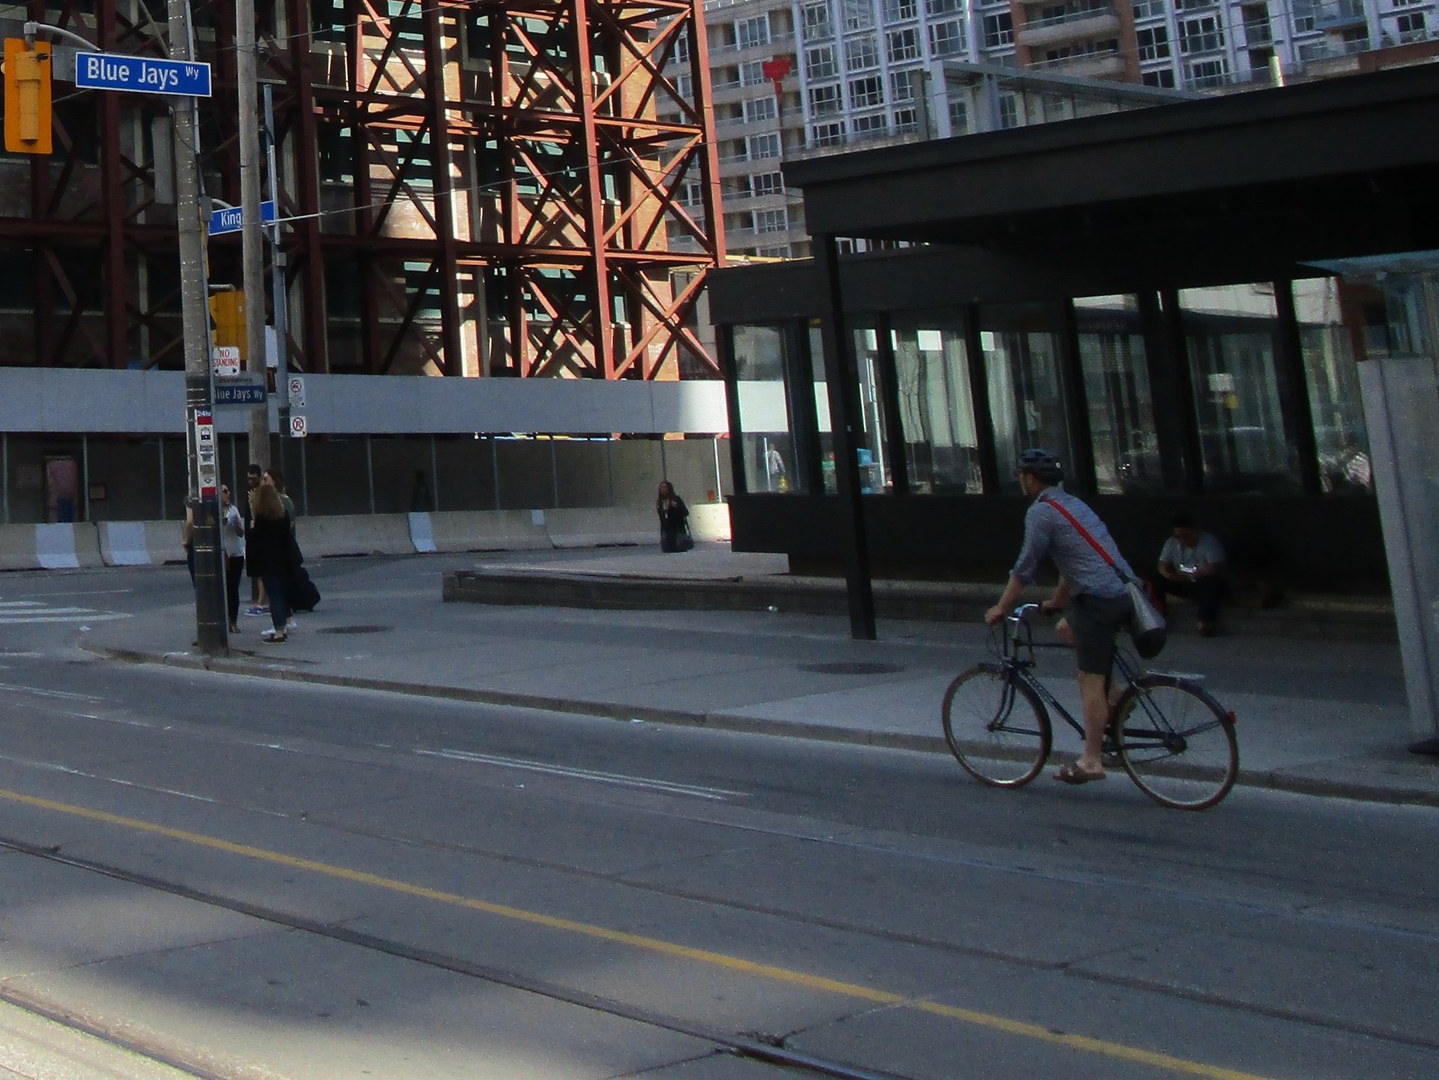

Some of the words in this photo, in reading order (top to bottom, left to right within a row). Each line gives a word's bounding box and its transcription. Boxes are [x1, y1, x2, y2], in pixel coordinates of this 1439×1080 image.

[87, 57, 130, 82] Blue
[137, 62, 179, 90] Jays
[185, 65, 200, 80] Wy
[221, 210, 242, 229] King
[219, 349, 230, 358] NO
[213, 357, 239, 367] STANDING
[216, 388, 230, 399] lue
[232, 388, 251, 402] Jays
[254, 390, 263, 400] Wy
